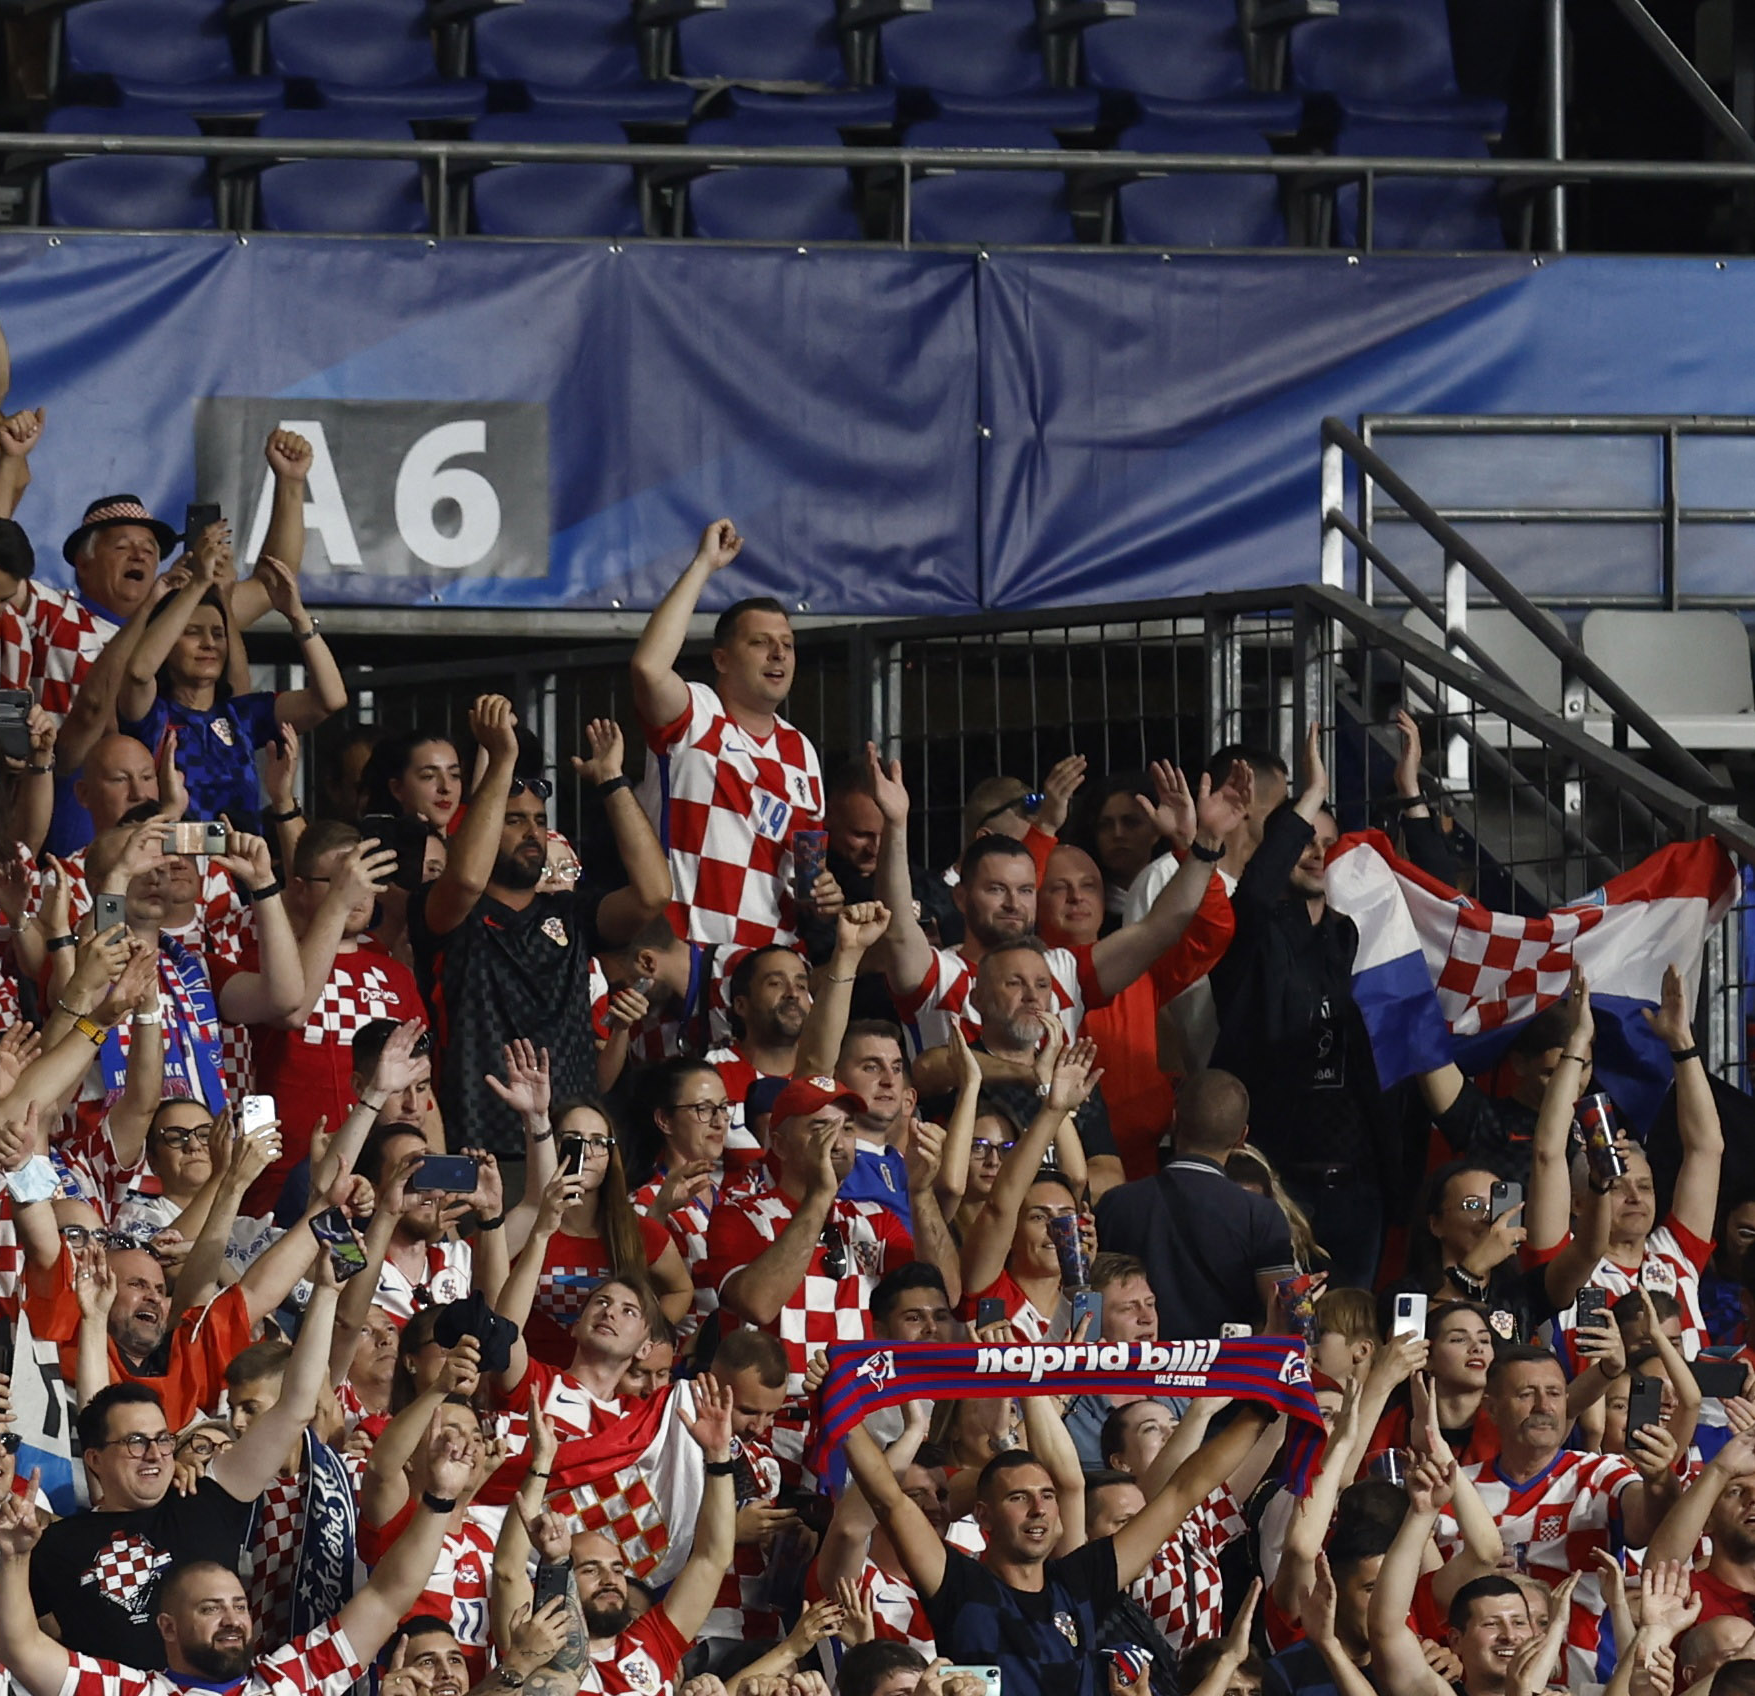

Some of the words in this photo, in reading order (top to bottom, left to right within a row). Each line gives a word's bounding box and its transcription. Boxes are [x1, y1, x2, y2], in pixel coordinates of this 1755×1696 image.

[758, 793, 788, 839] 19
[974, 1341, 1129, 1383] naprid
[1137, 1338, 1222, 1372] bili!
[1154, 1373, 1173, 1386] VAŠ
[1175, 1374, 1208, 1387] SJEVER
[457, 1601, 483, 1643] 17
